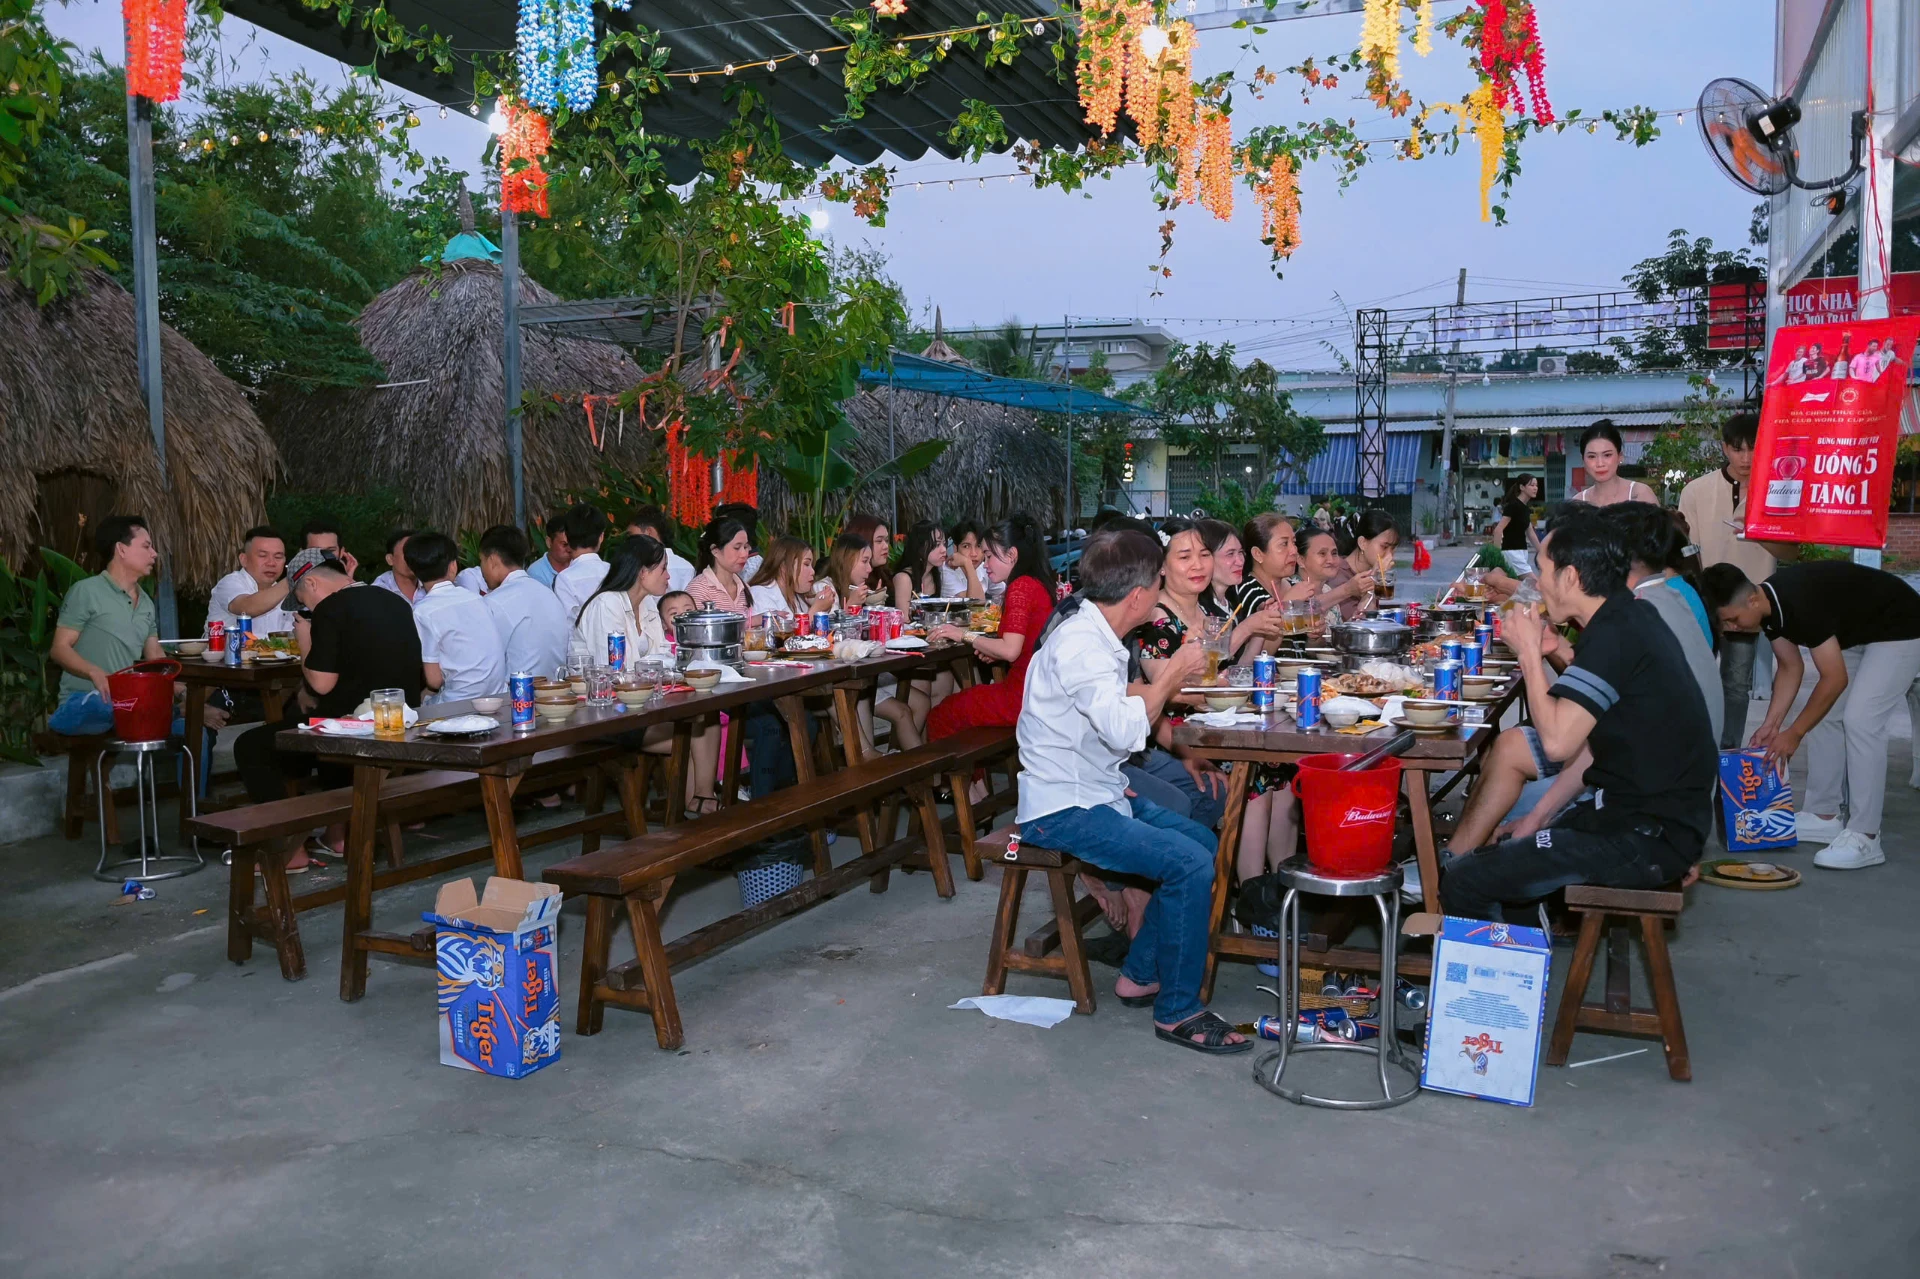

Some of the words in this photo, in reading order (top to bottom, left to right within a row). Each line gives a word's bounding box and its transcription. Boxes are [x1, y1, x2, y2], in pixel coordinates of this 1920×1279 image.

[1819, 290, 1853, 311] NHÀ
[1814, 449, 1863, 475] UỐNG
[1865, 448, 1878, 475] 5
[1810, 481, 1856, 507] TẶNG
[1860, 479, 1869, 505] 1
[1737, 758, 1763, 804] Tiger
[521, 958, 543, 1018] Tiger
[470, 998, 498, 1069] Tiger
[1461, 1032, 1504, 1055] Tiger
